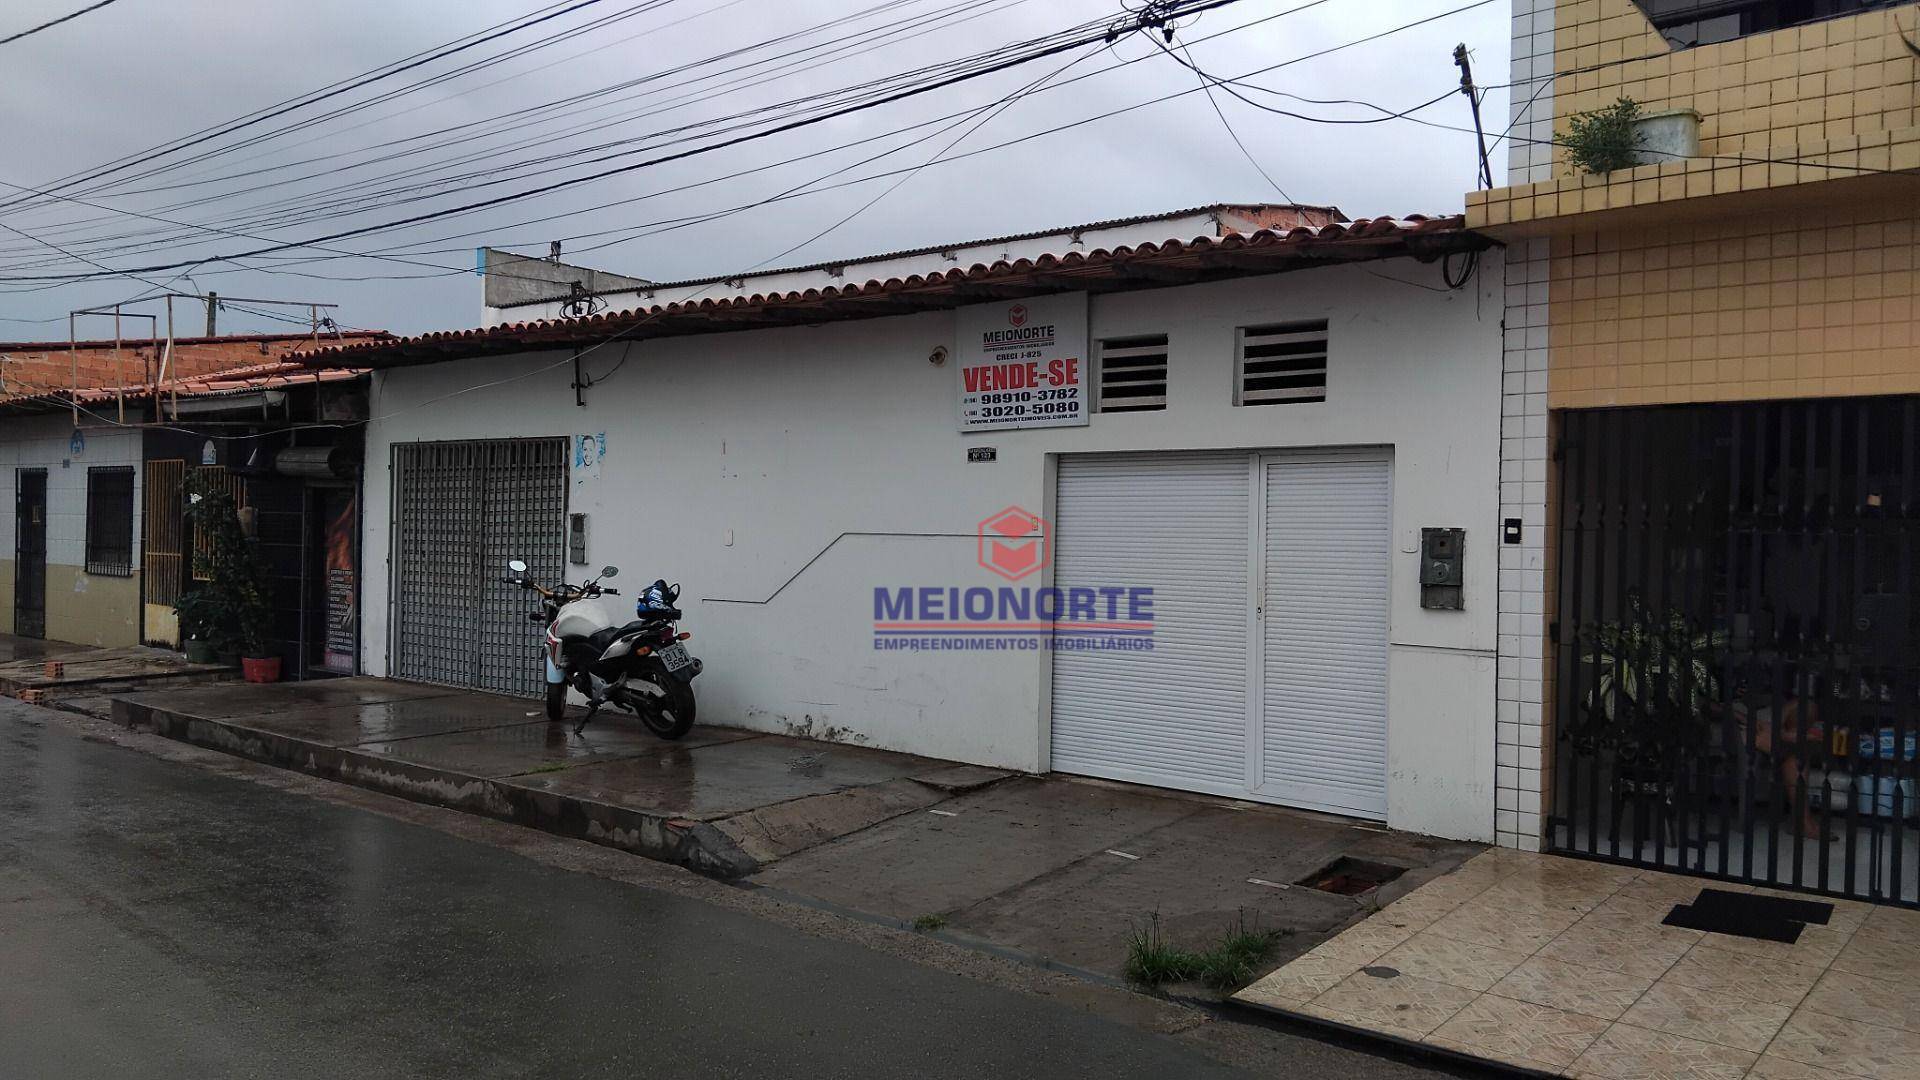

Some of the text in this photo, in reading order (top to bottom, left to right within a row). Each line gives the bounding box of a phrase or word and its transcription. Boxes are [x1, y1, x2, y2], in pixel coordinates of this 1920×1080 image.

[983, 325, 1055, 343] MEIONORTE
[996, 353, 1018, 361] CRECI
[963, 358, 1079, 393] VENDE-SE
[981, 387, 1078, 405] 98910-3782
[981, 401, 1079, 418] 3020-5080
